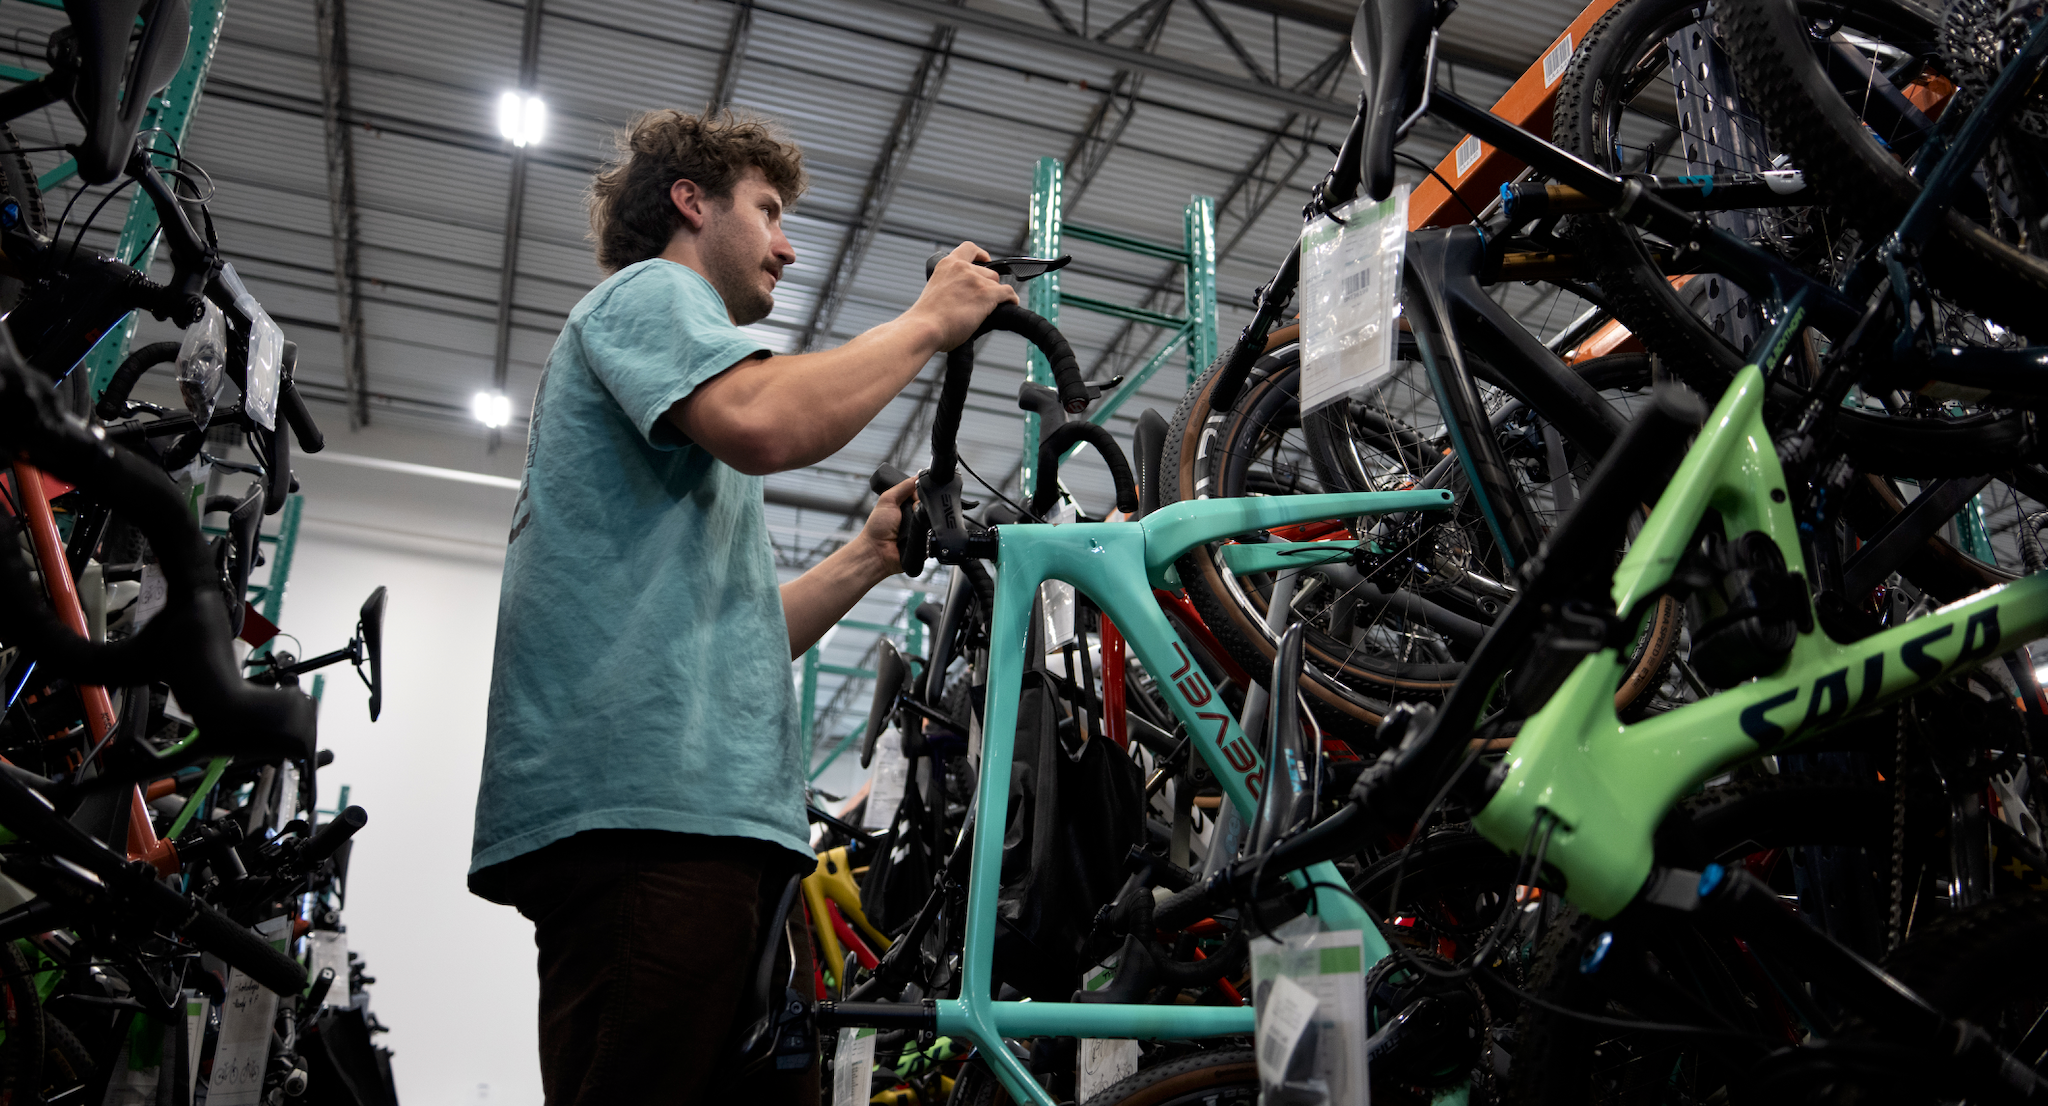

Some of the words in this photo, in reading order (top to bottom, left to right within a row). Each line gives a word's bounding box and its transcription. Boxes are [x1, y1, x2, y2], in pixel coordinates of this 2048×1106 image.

[1652, 626, 1668, 657] SPEED
[1662, 594, 1673, 624] ERRA
[1170, 641, 1265, 800] REVEL
[1739, 604, 2000, 750] SALSA
